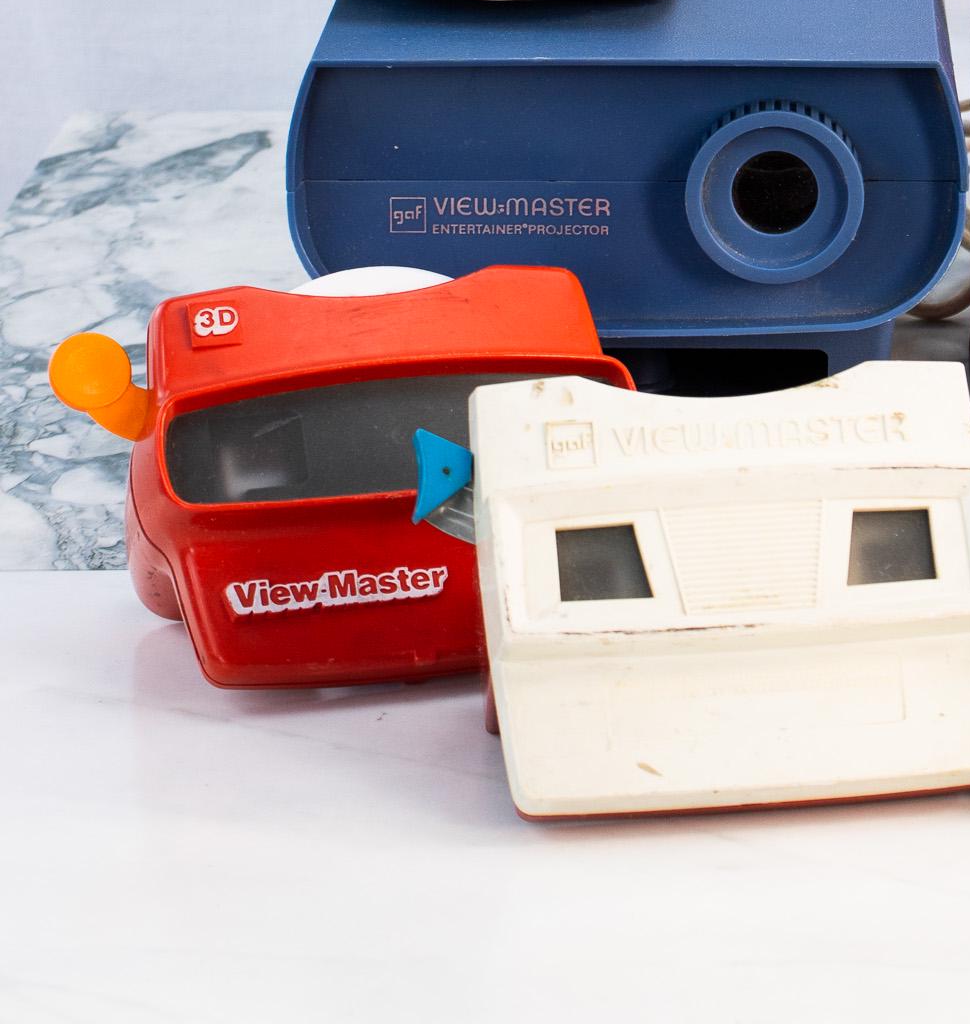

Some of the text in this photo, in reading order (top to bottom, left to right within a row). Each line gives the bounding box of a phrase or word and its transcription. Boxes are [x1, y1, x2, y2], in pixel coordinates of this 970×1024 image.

[393, 196, 611, 224] gaf VIEW-MASTER
[528, 224, 609, 236] PROJECTOR
[197, 307, 237, 331] 3D
[610, 412, 911, 457] VIEW-MASTER
[232, 568, 446, 610] View-Master
